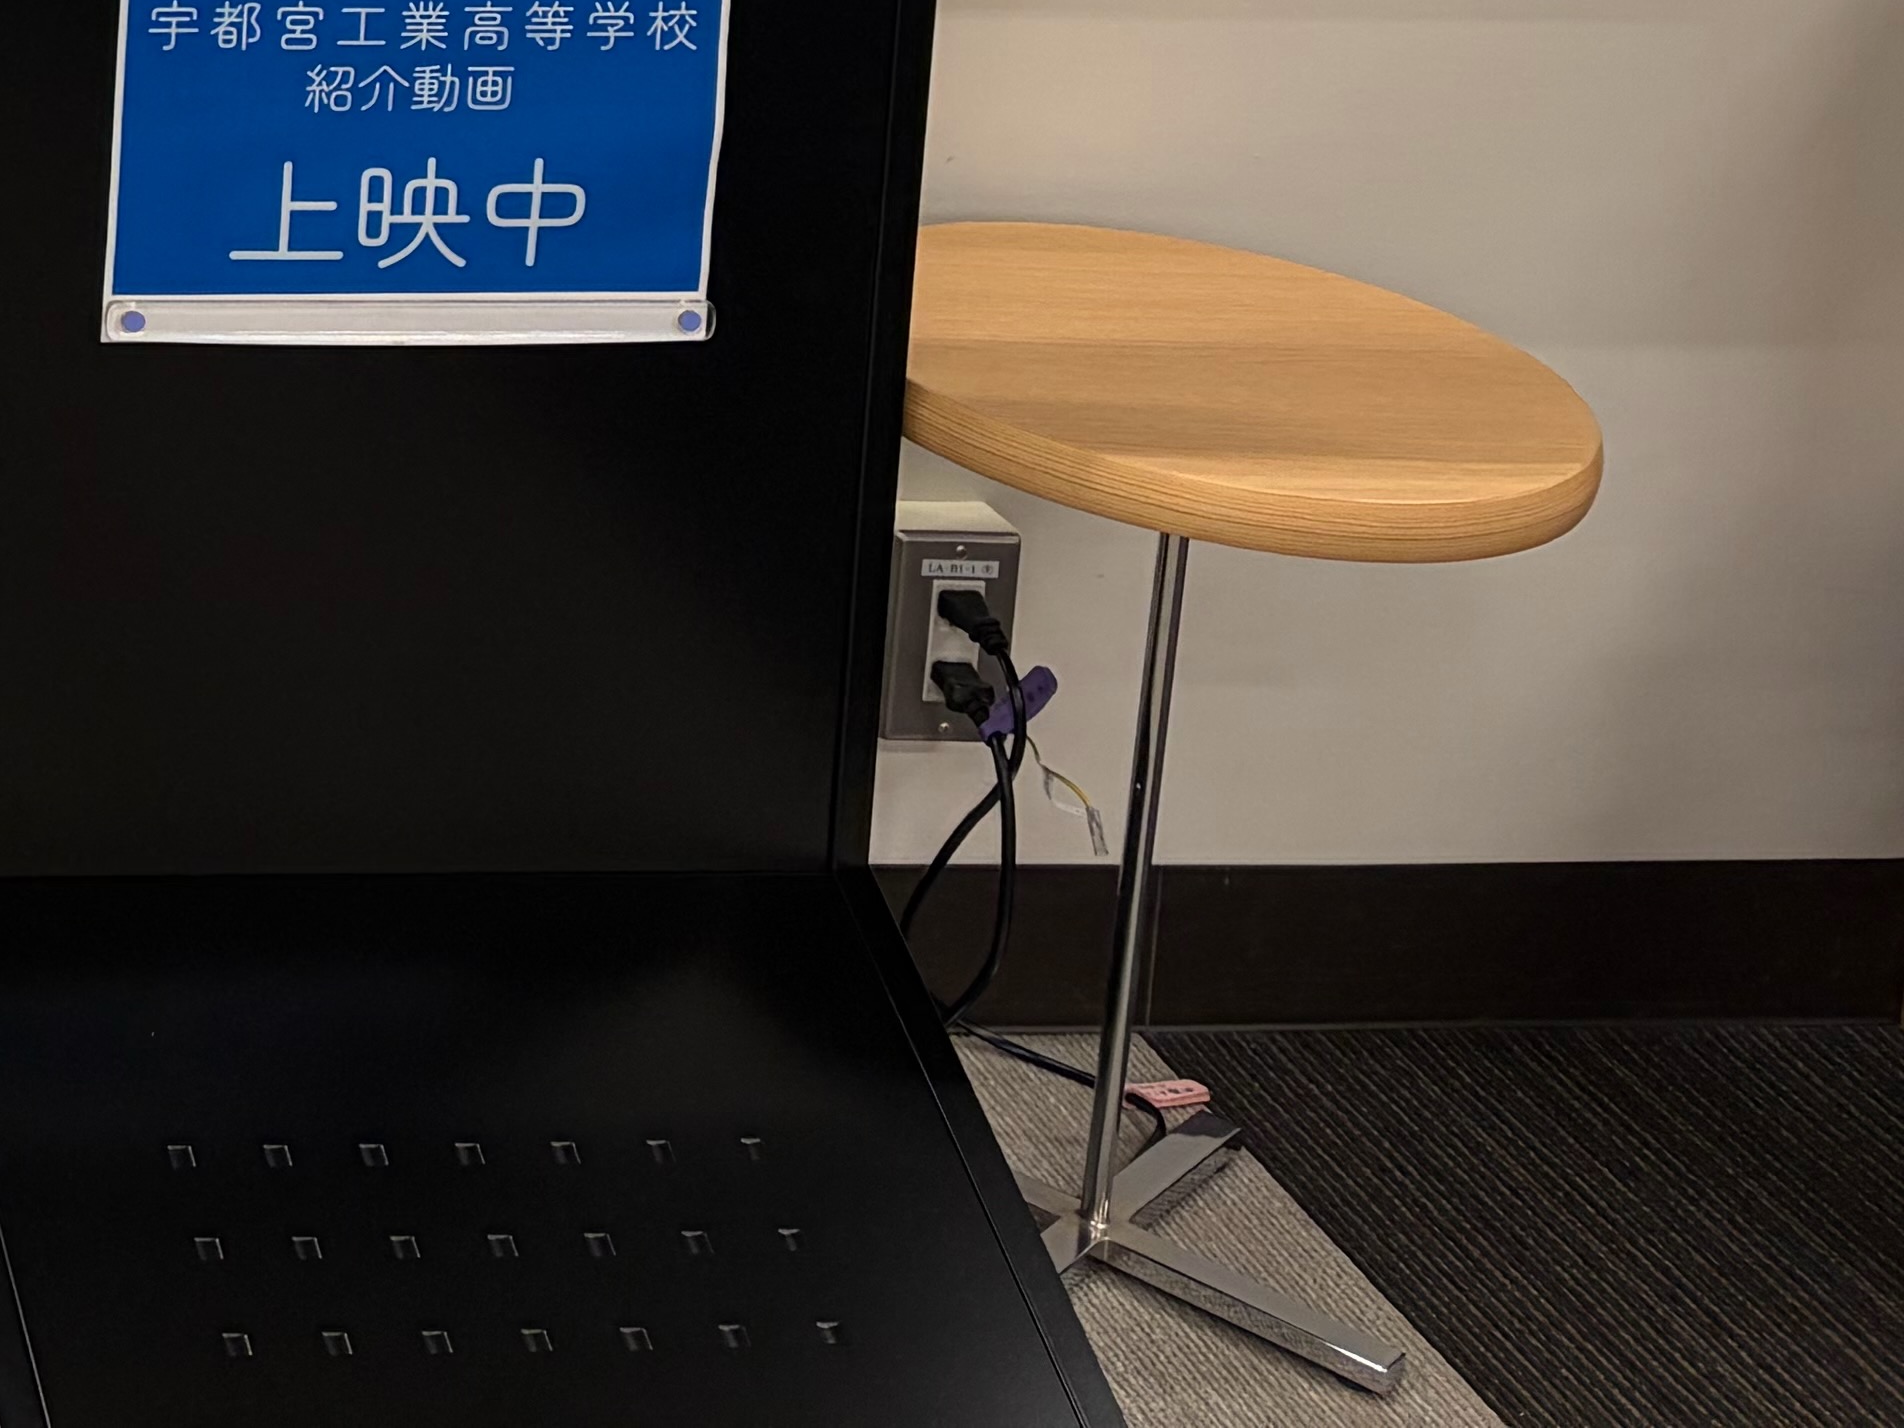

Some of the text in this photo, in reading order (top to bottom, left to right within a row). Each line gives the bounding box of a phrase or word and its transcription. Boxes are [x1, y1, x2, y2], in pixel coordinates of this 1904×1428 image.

[304, 62, 516, 114] 紹介動画
[228, 156, 587, 270] 上映中
